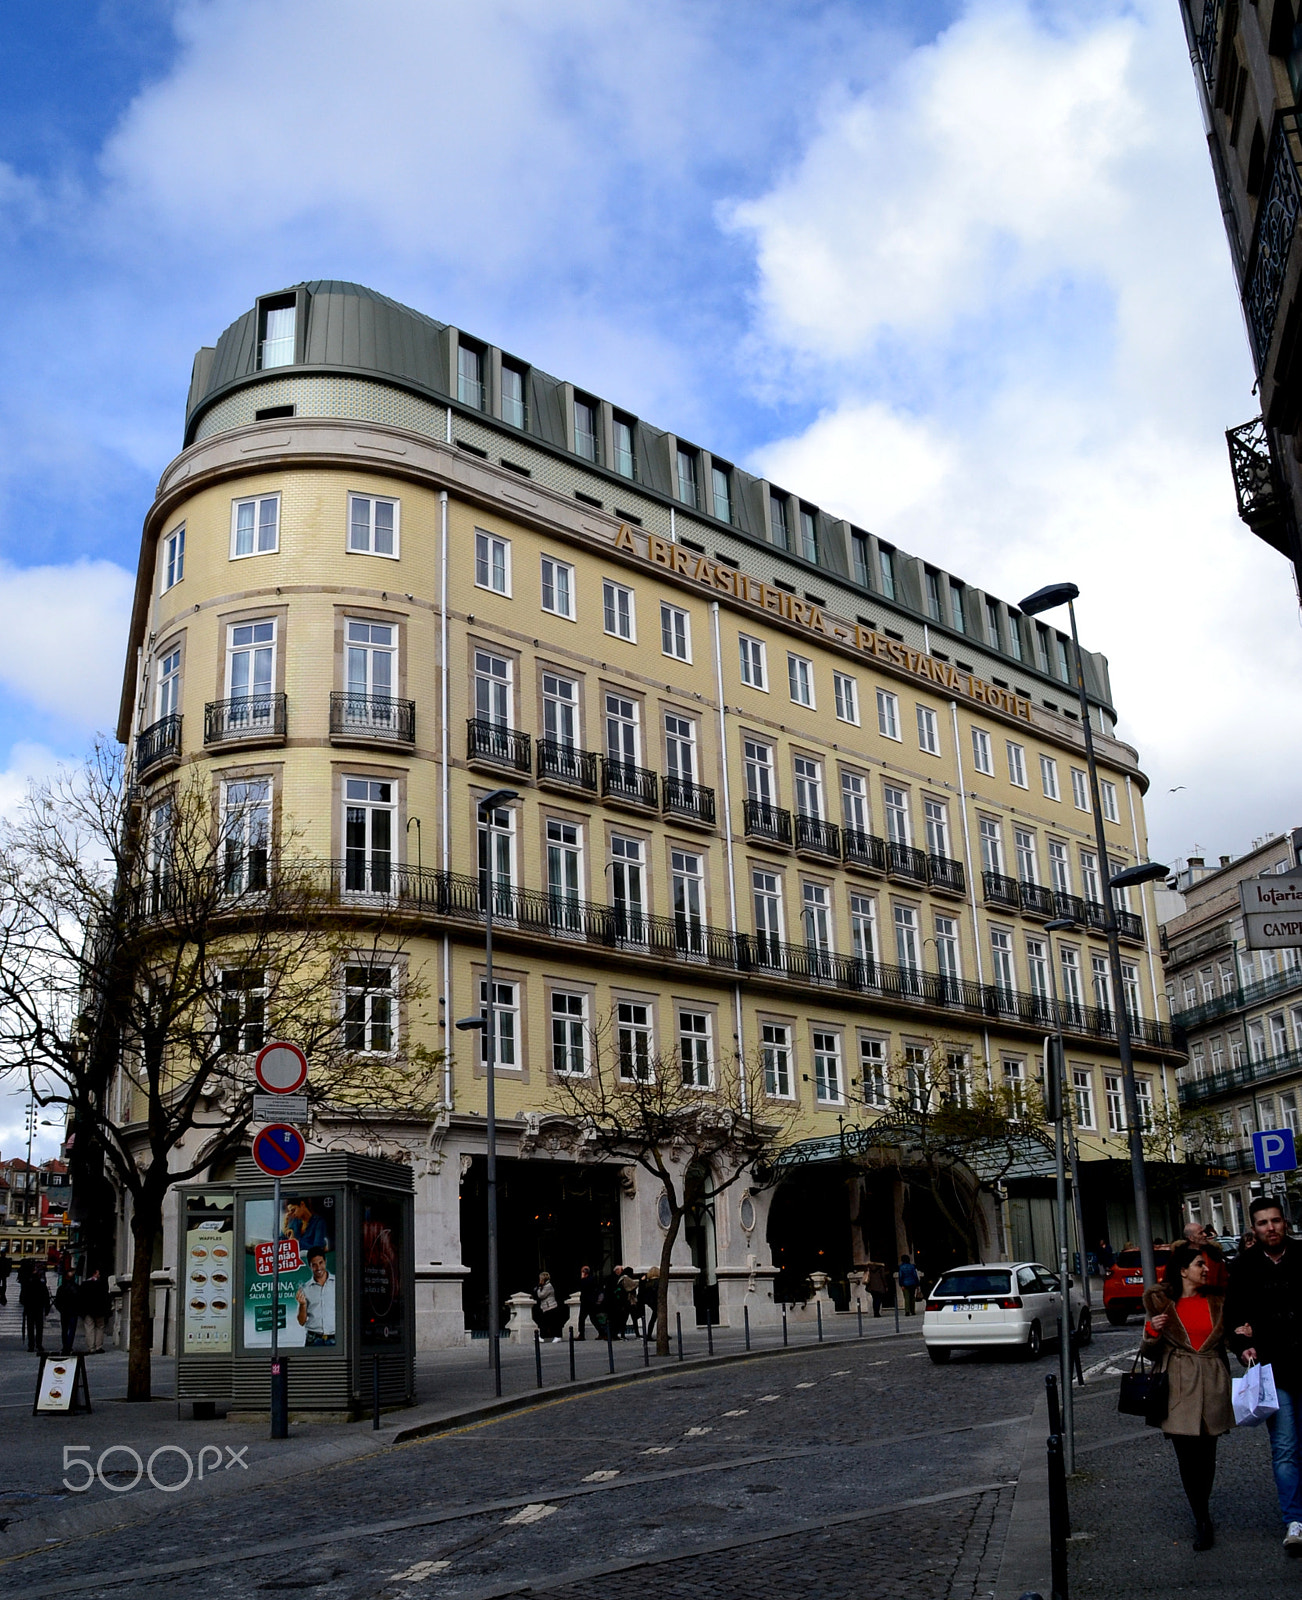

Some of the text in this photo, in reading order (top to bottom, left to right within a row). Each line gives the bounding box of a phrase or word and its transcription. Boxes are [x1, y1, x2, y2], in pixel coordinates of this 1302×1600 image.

[615, 523, 639, 555] A
[648, 535, 828, 634] BRASILEIRA
[855, 625, 963, 692] PESTANA
[968, 675, 1039, 725] HOTEL
[1261, 1134, 1285, 1169] P
[261, 1242, 291, 1255] SAVEI
[265, 1251, 296, 1263] renião
[258, 1259, 297, 1273] da ofia!
